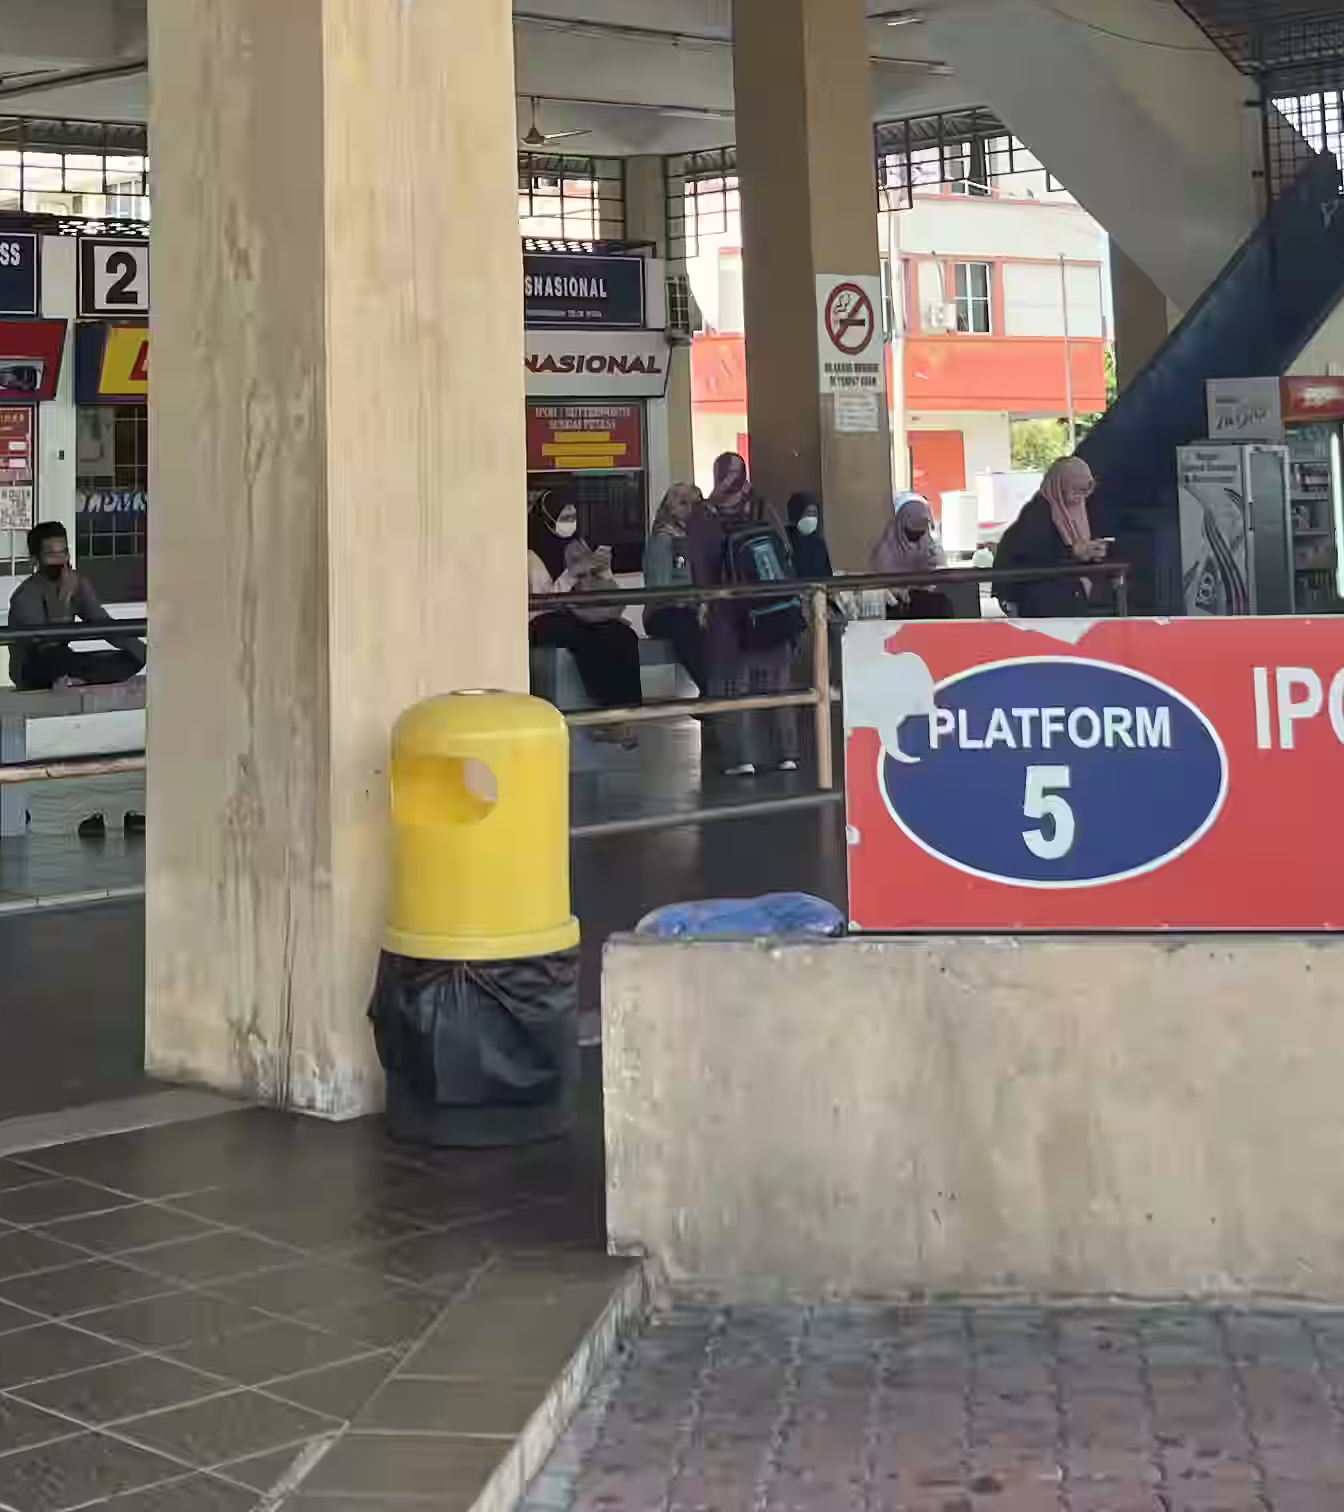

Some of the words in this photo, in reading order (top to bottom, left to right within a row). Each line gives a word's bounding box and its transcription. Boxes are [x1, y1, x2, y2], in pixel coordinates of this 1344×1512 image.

[105, 251, 138, 304] 2
[928, 706, 1172, 750] PLATFORM
[1021, 764, 1076, 860] 5
